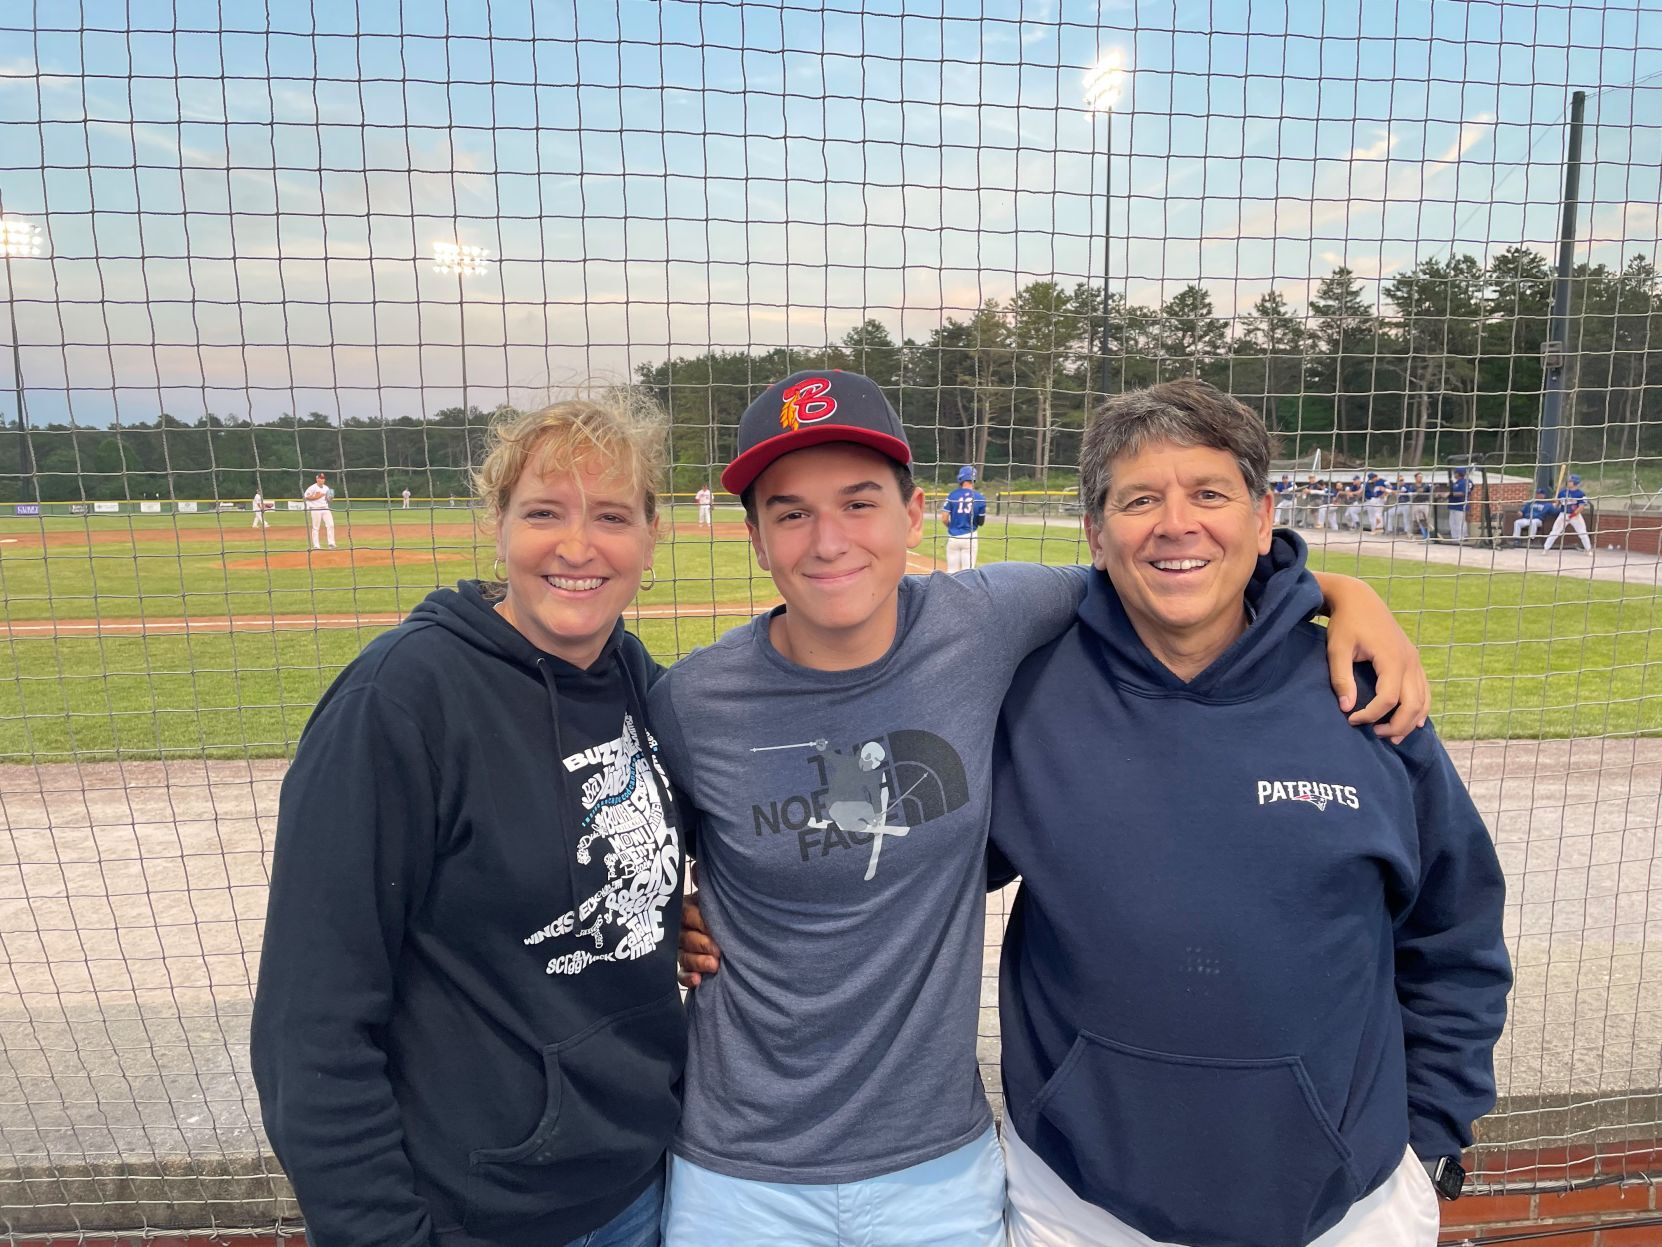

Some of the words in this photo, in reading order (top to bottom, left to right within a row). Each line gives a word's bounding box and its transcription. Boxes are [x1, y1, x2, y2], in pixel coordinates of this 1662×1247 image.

[783, 378, 837, 423] B
[1257, 780, 1360, 809] PATRIOTS
[524, 911, 575, 945] WINGS
